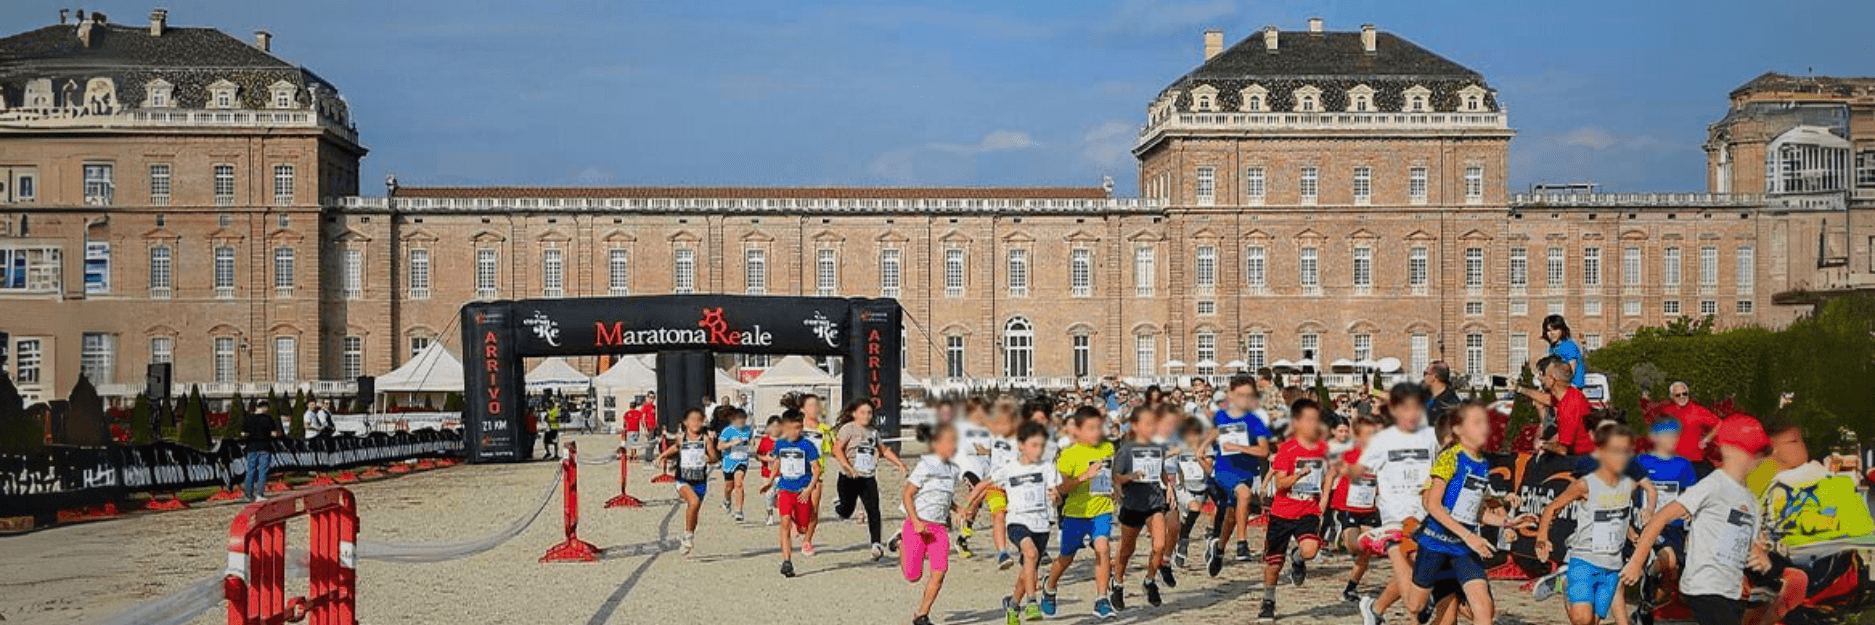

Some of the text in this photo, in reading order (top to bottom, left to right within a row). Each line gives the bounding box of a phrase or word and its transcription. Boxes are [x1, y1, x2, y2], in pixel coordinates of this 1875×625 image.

[484, 331, 502, 415] ARRIVO
[481, 419, 507, 432] 21 KM
